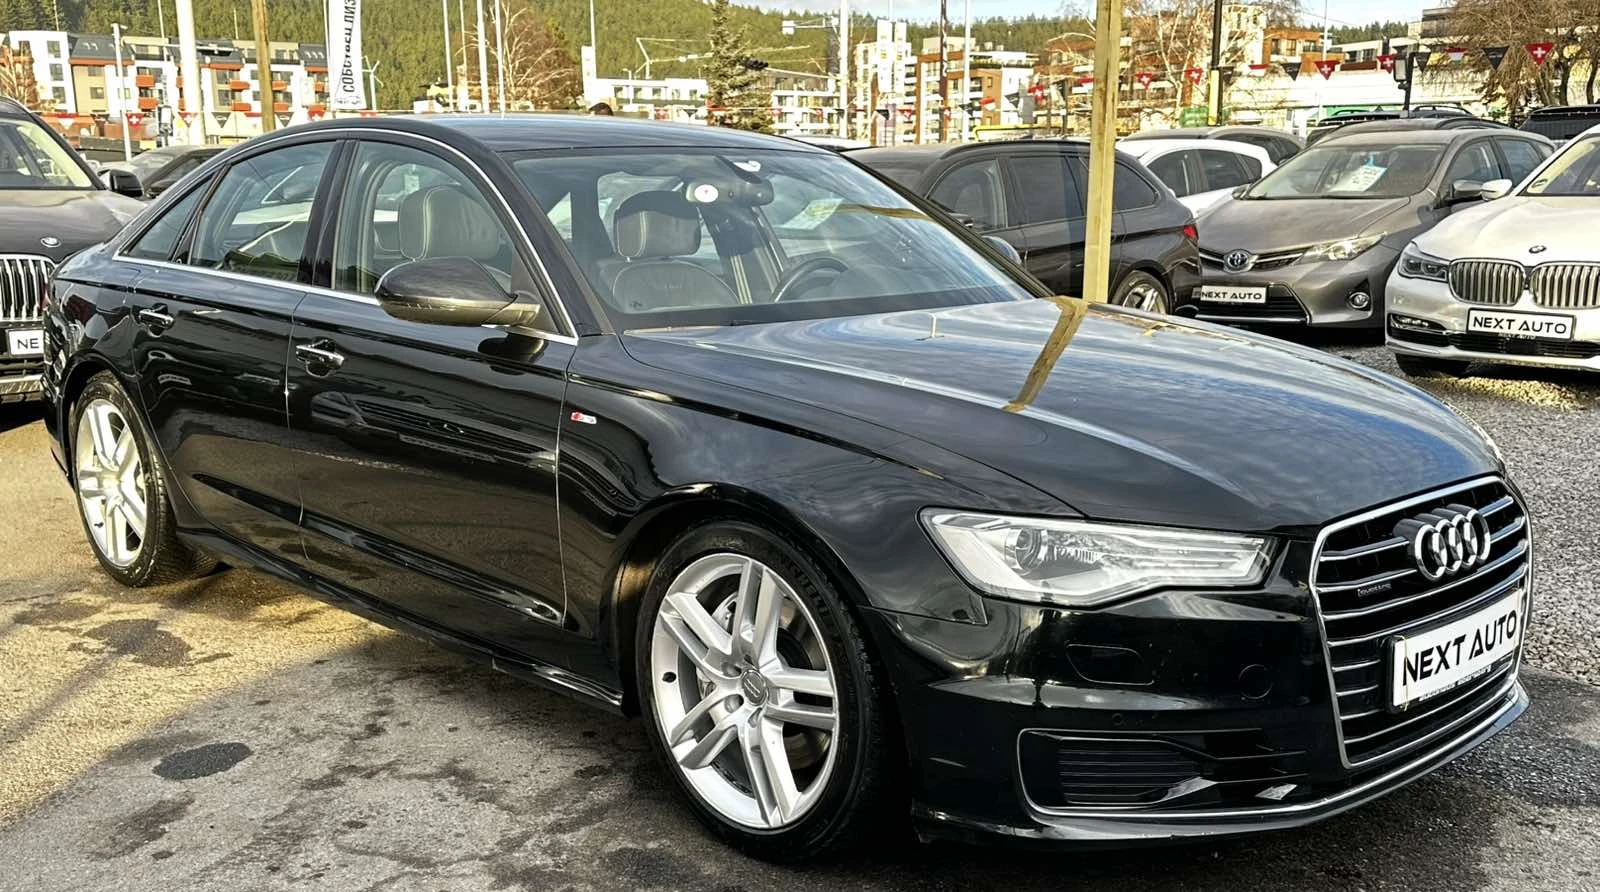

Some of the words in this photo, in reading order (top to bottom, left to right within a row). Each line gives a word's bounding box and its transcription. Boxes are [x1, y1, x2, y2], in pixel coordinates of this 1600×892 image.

[1201, 291, 1228, 299] NEXT
[1230, 292, 1262, 300] AUTO
[1472, 316, 1515, 330] NEXT
[1518, 320, 1567, 334] AUTO
[1402, 634, 1467, 687] NEXT
[1468, 610, 1518, 661] AUTO
